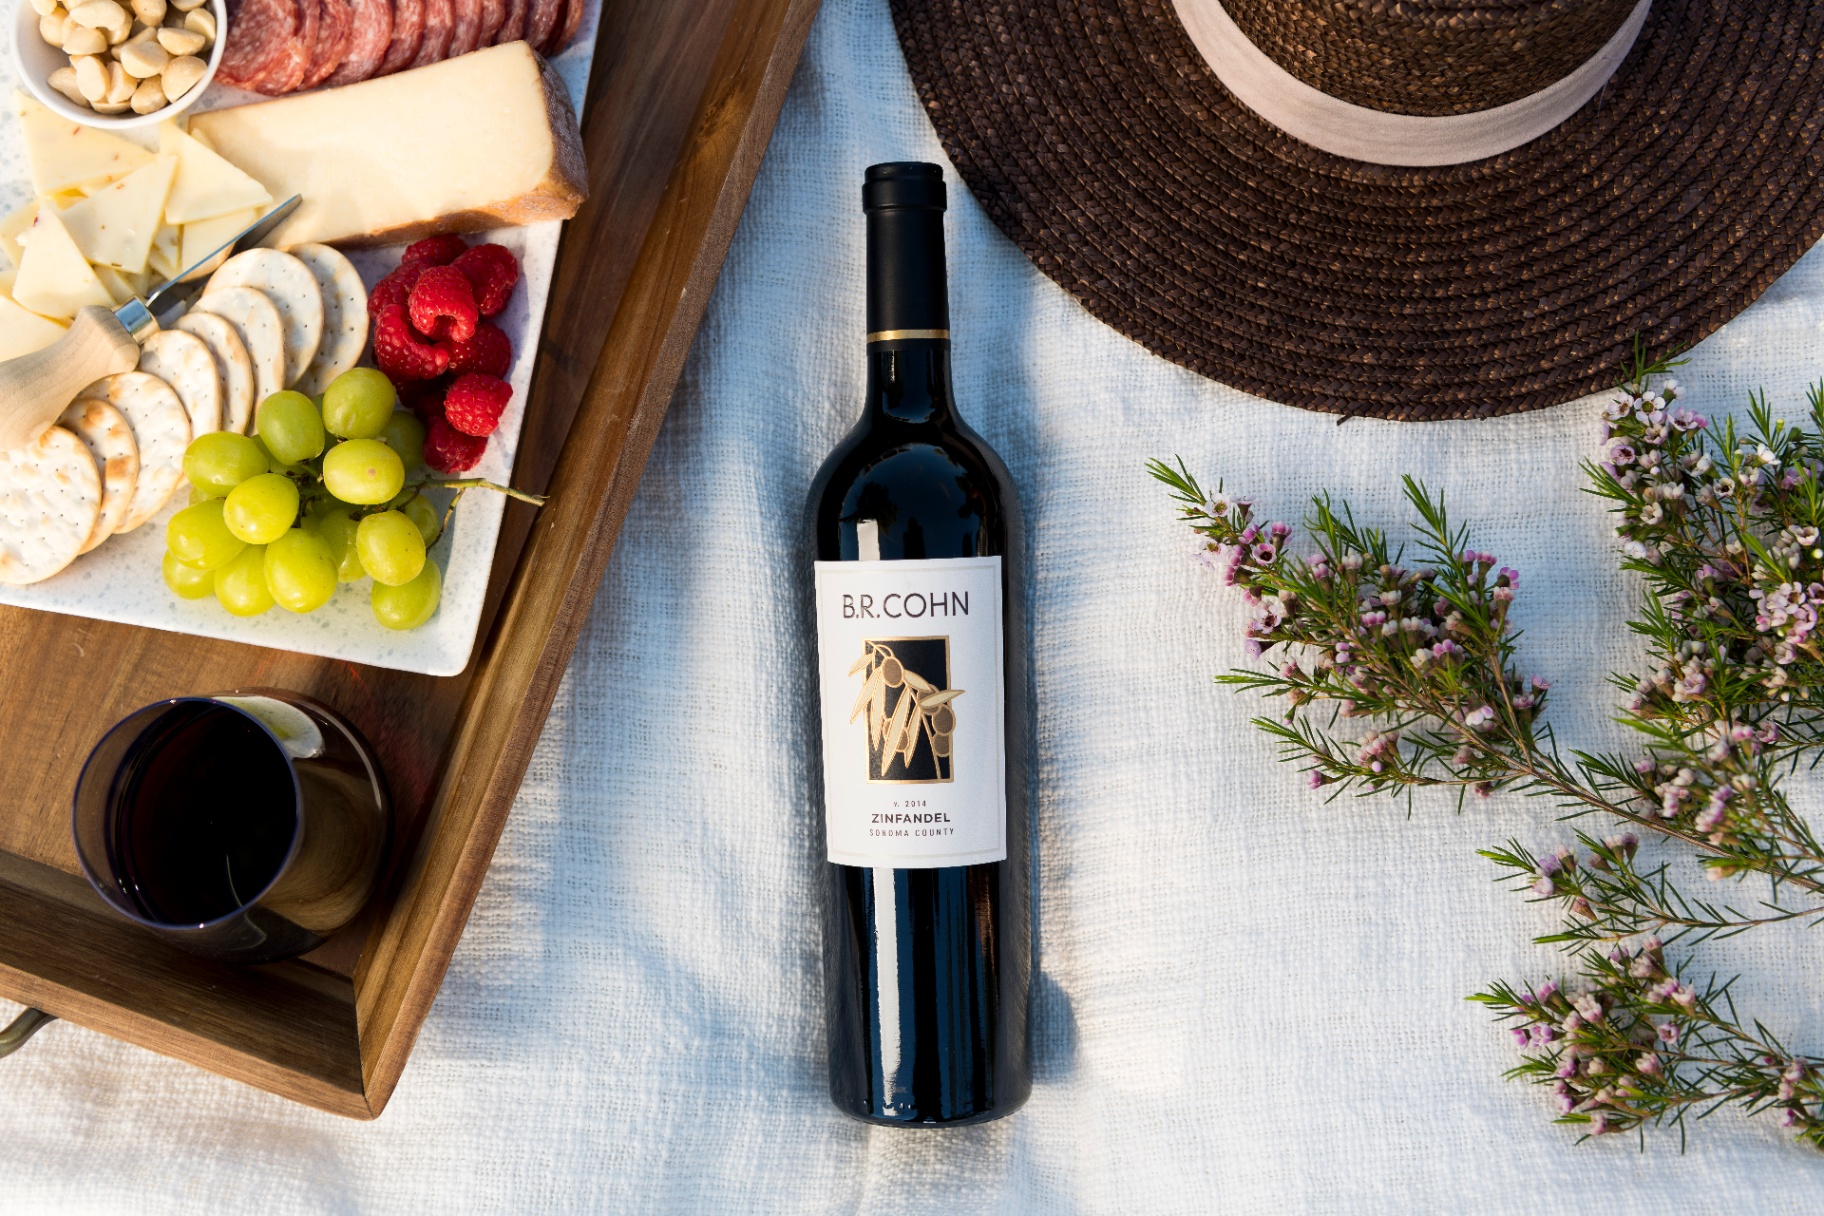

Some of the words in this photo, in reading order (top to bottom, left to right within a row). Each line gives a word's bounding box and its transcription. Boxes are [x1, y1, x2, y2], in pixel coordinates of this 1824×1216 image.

[871, 813, 950, 823] ZINFANDEL
[869, 828, 909, 836] SONOMA
[915, 828, 954, 836] COUNTY
